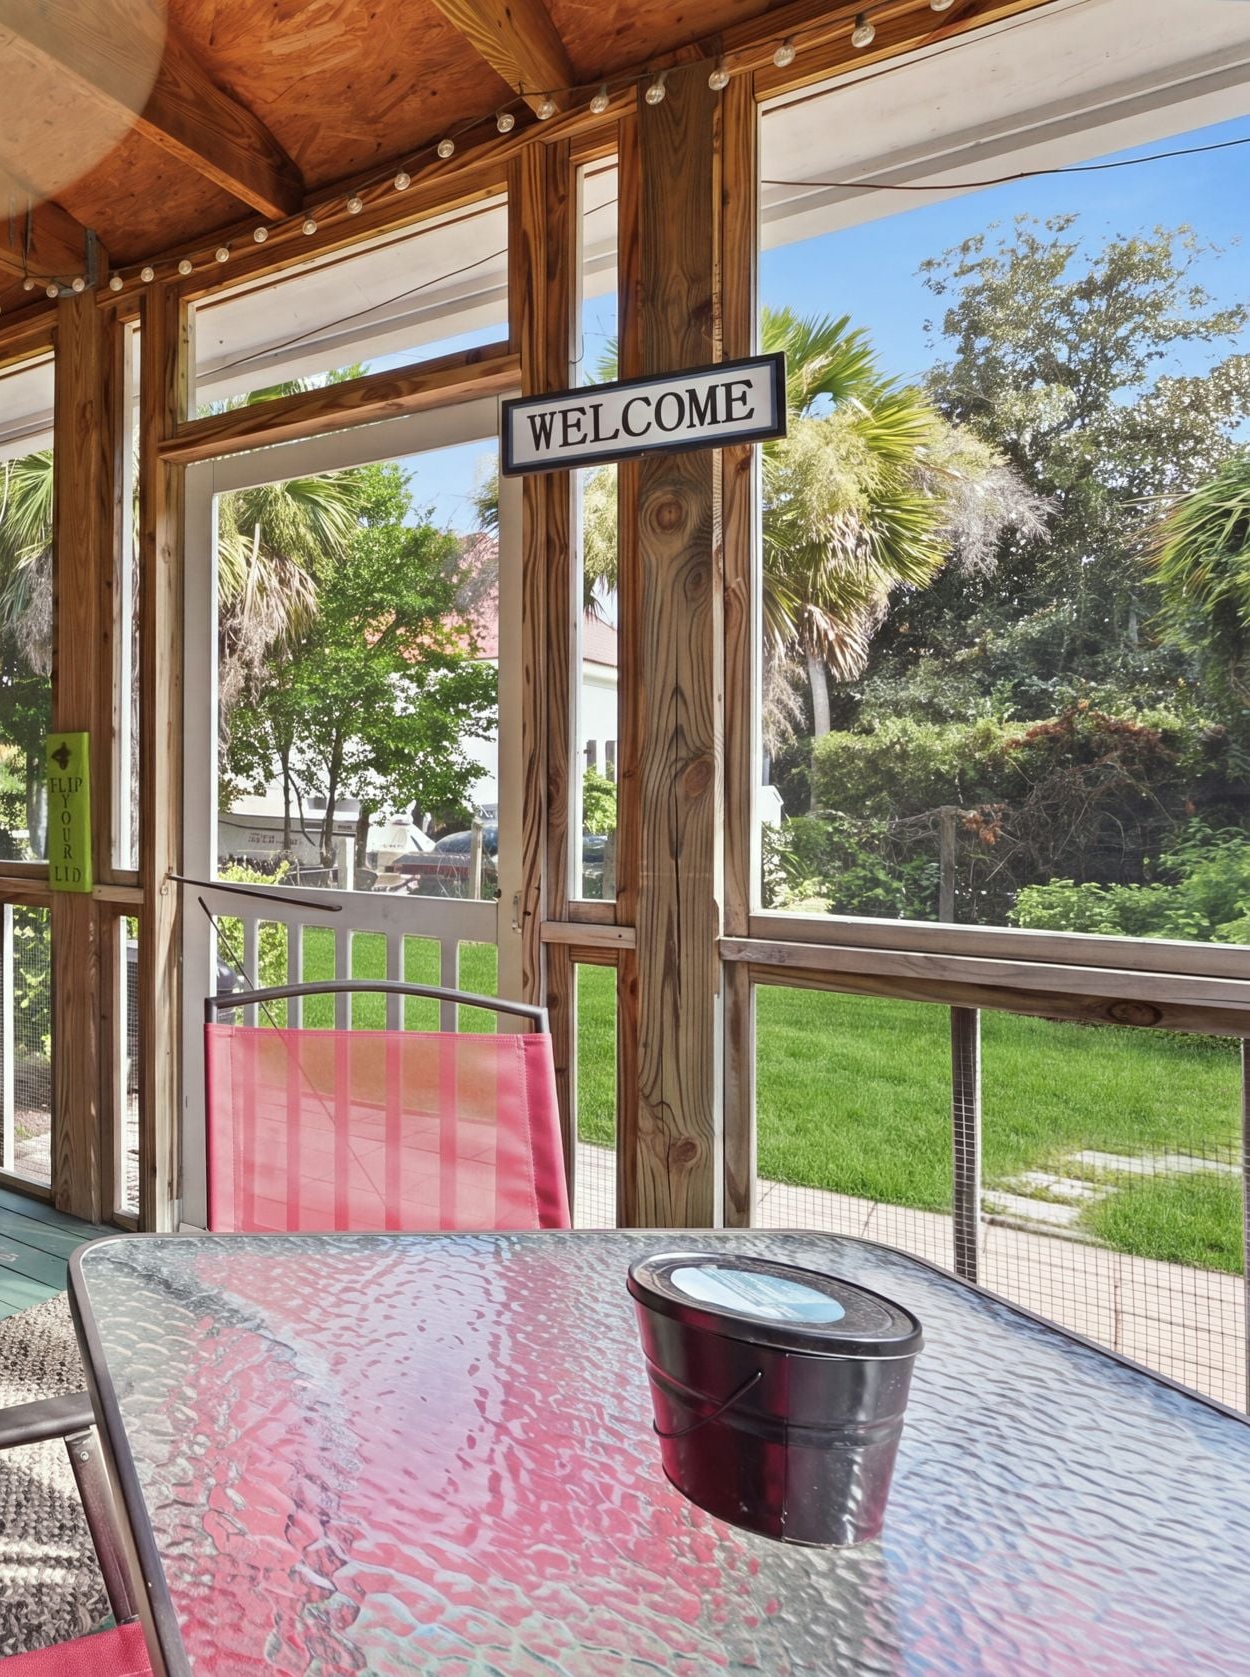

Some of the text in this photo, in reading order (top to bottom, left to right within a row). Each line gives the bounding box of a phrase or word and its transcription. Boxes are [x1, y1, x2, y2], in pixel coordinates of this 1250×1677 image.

[527, 379, 755, 451] WELCOME
[50, 777, 83, 793] FLIP
[55, 865, 81, 883] LID
